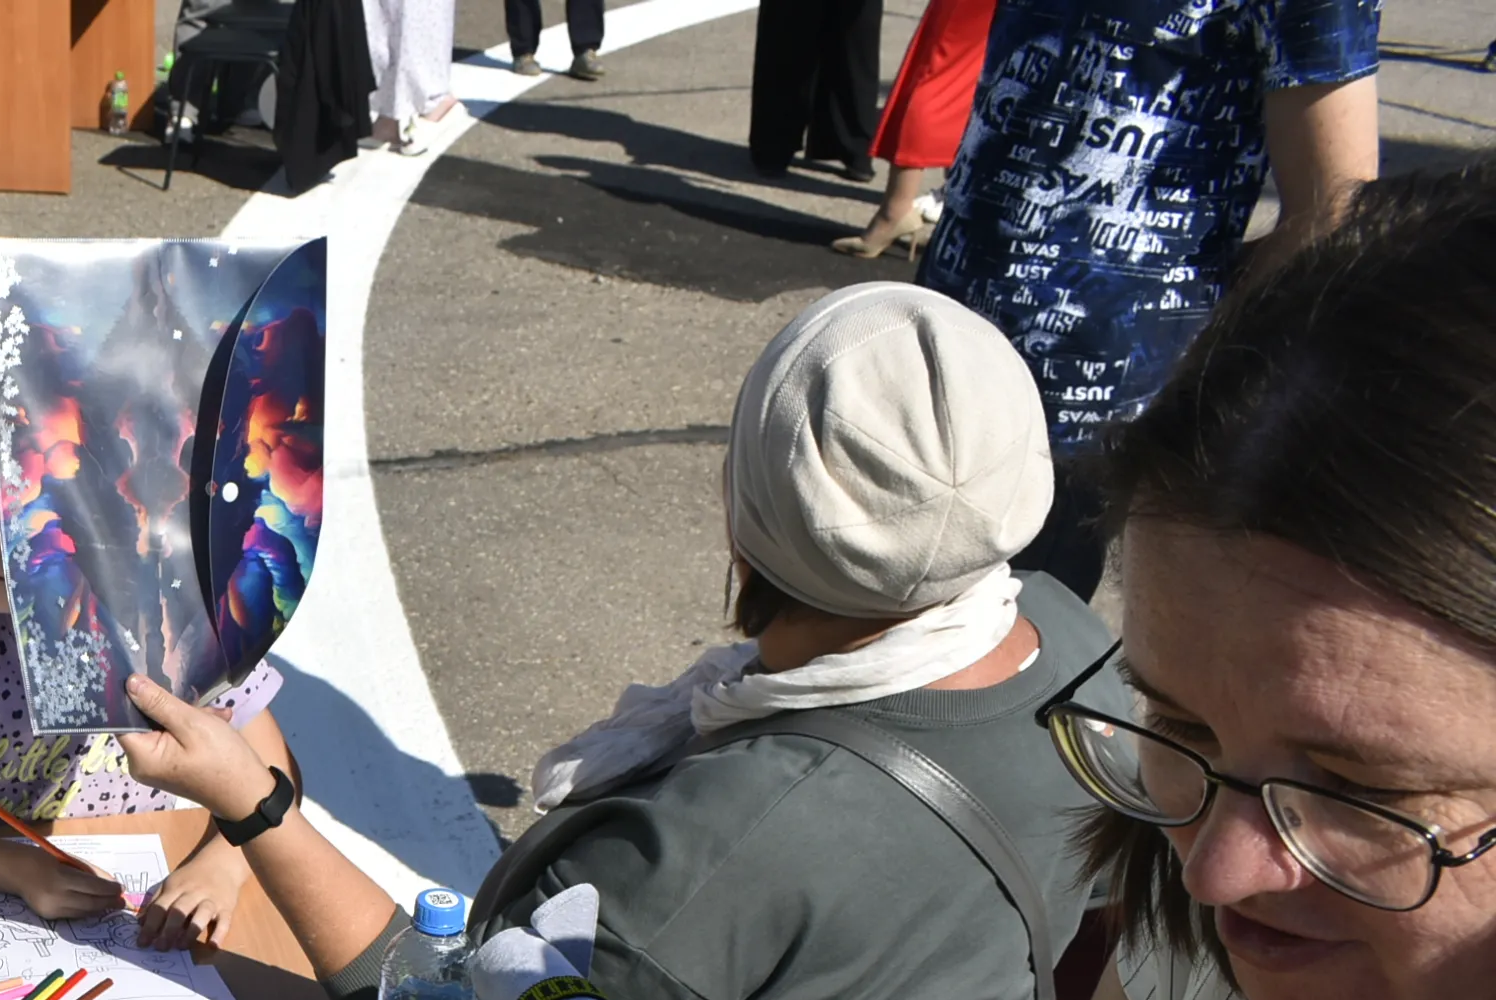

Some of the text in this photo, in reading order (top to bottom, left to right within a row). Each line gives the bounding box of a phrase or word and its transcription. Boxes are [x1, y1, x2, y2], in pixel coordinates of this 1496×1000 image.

[1021, 242, 1060, 258] WAS
[1004, 263, 1052, 280] JUST
[1062, 385, 1114, 401] JUST
